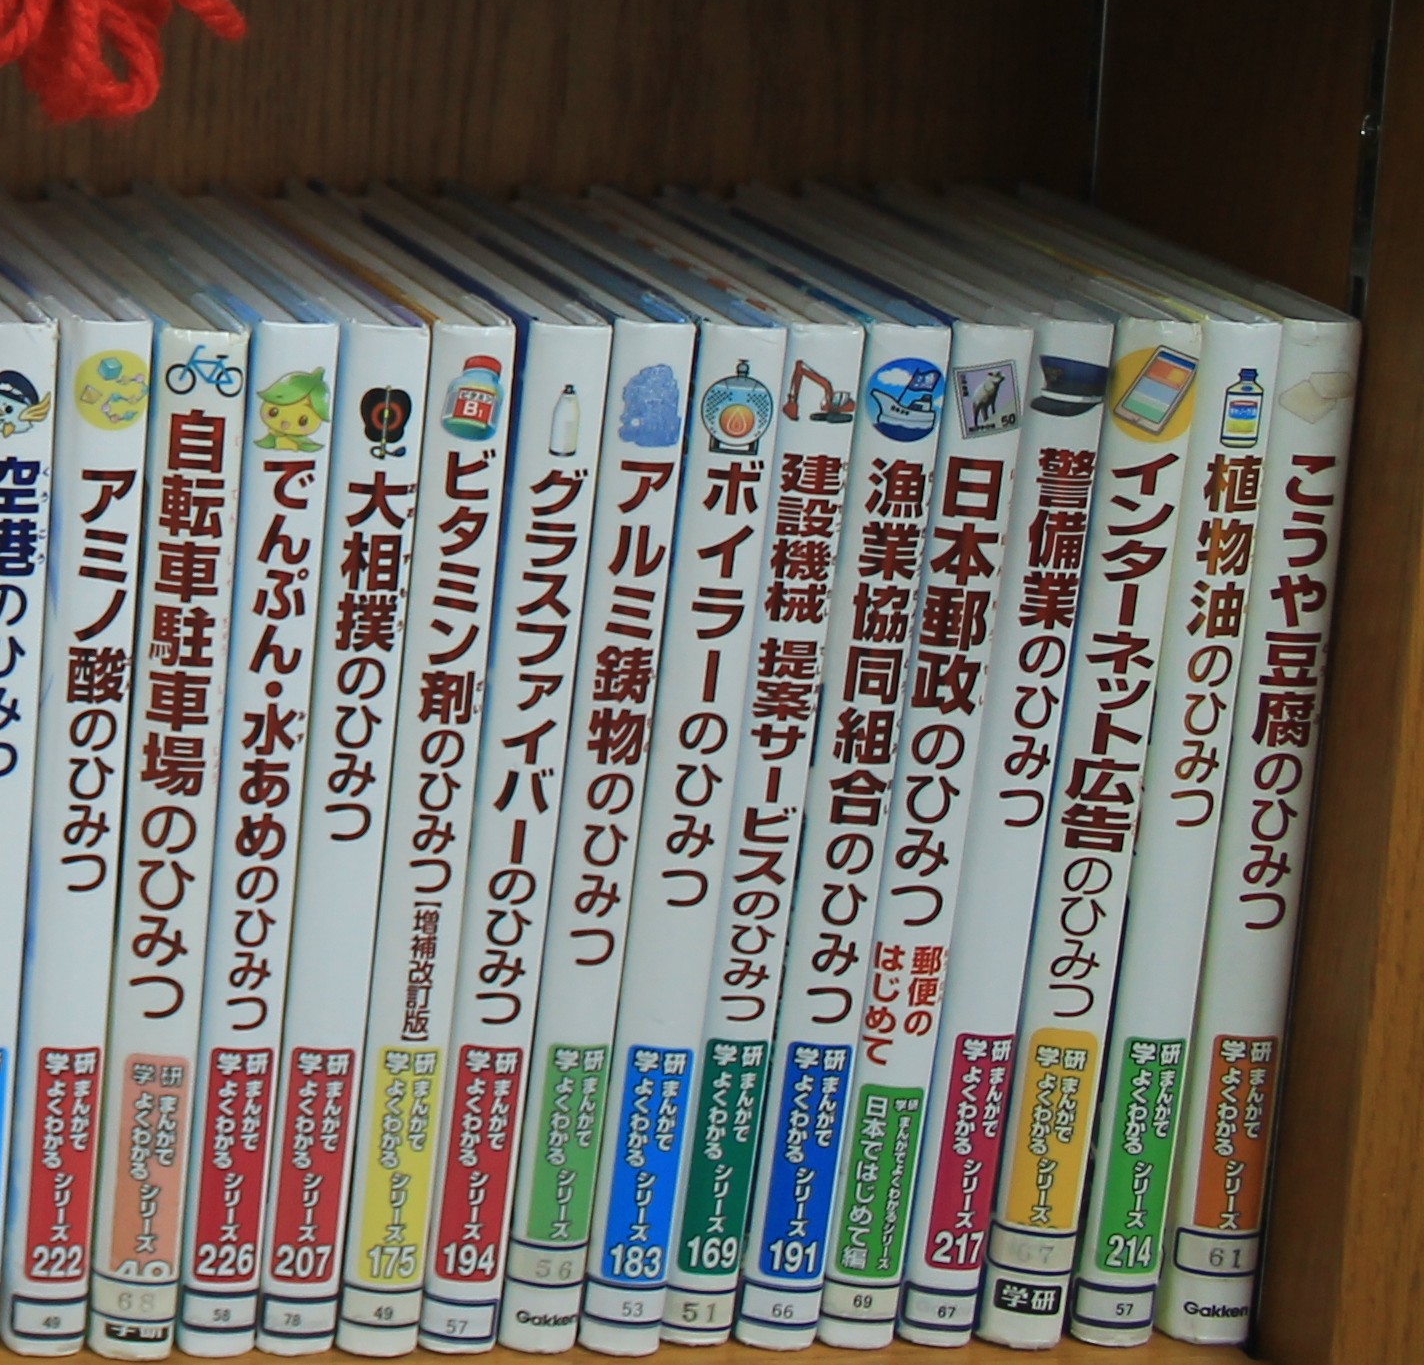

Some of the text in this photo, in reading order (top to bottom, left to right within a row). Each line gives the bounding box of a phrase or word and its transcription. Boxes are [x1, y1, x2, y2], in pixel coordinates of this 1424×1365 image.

[763, 452, 844, 624] 建設機械
[998, 447, 1096, 828] 警備業のひみつ
[1170, 453, 1264, 828] 植物油のひみつ
[324, 470, 410, 841] 大相撲のひみつ
[60, 468, 137, 893] アミノ酸のひみつ
[409, 449, 497, 894] ビタミン剤のひみつ
[661, 460, 765, 907] ボイラーのひみつ
[890, 455, 1005, 927] 日本郵政のひみつ
[1238, 454, 1337, 930] こうや豆腐のひみつ
[128, 408, 225, 1020] 自転車駐車場のひみつ
[569, 459, 674, 966] アルミ鋳物のひみつ
[226, 460, 317, 1031] でんぷん・水あめのひみつ
[474, 468, 588, 1025] グラスファイバーのひみつ
[805, 457, 927, 1024] 漁業協同組合のひみつ
[1048, 452, 1180, 1018] インターネット広告のひみつ
[45, 1052, 97, 1075] 学研
[217, 1052, 268, 1075] 学研
[298, 1053, 350, 1075] 学研
[385, 1051, 437, 1074] 学研
[465, 1050, 518, 1073] 学研
[554, 1048, 605, 1072] 学研
[634, 1049, 686, 1075] 学研
[712, 1043, 764, 1067] 学研
[794, 1046, 846, 1071] 学研
[962, 1038, 1012, 1062] 学研
[1036, 1045, 1088, 1071] 学研
[1130, 1042, 1182, 1065] 学研
[1220, 1040, 1273, 1063] 学研
[132, 1064, 183, 1088] 学研
[841, 1094, 890, 1270] 日本ではじめて編
[31, 1246, 85, 1278] 222
[198, 1243, 254, 1277] 226
[275, 1244, 333, 1278] 207
[368, 1244, 417, 1278] 175
[443, 1243, 496, 1276] 194
[610, 1244, 663, 1278] 183
[687, 1235, 738, 1270] 169
[770, 1240, 817, 1273] 191
[933, 1230, 985, 1265] 217
[1106, 1235, 1152, 1269] 214
[1208, 1247, 1242, 1269] 61
[535, 1259, 573, 1280] 56
[621, 1300, 644, 1317] 53
[771, 1302, 795, 1319] 66
[852, 1294, 873, 1309] 69
[936, 1304, 956, 1319] 67
[1000, 1285, 1056, 1311] 学研
[1115, 1302, 1134, 1317] 57
[1183, 1300, 1249, 1319] Gakken
[373, 1306, 394, 1321] 49
[446, 1319, 467, 1335] 57
[681, 1302, 717, 1324] 51
